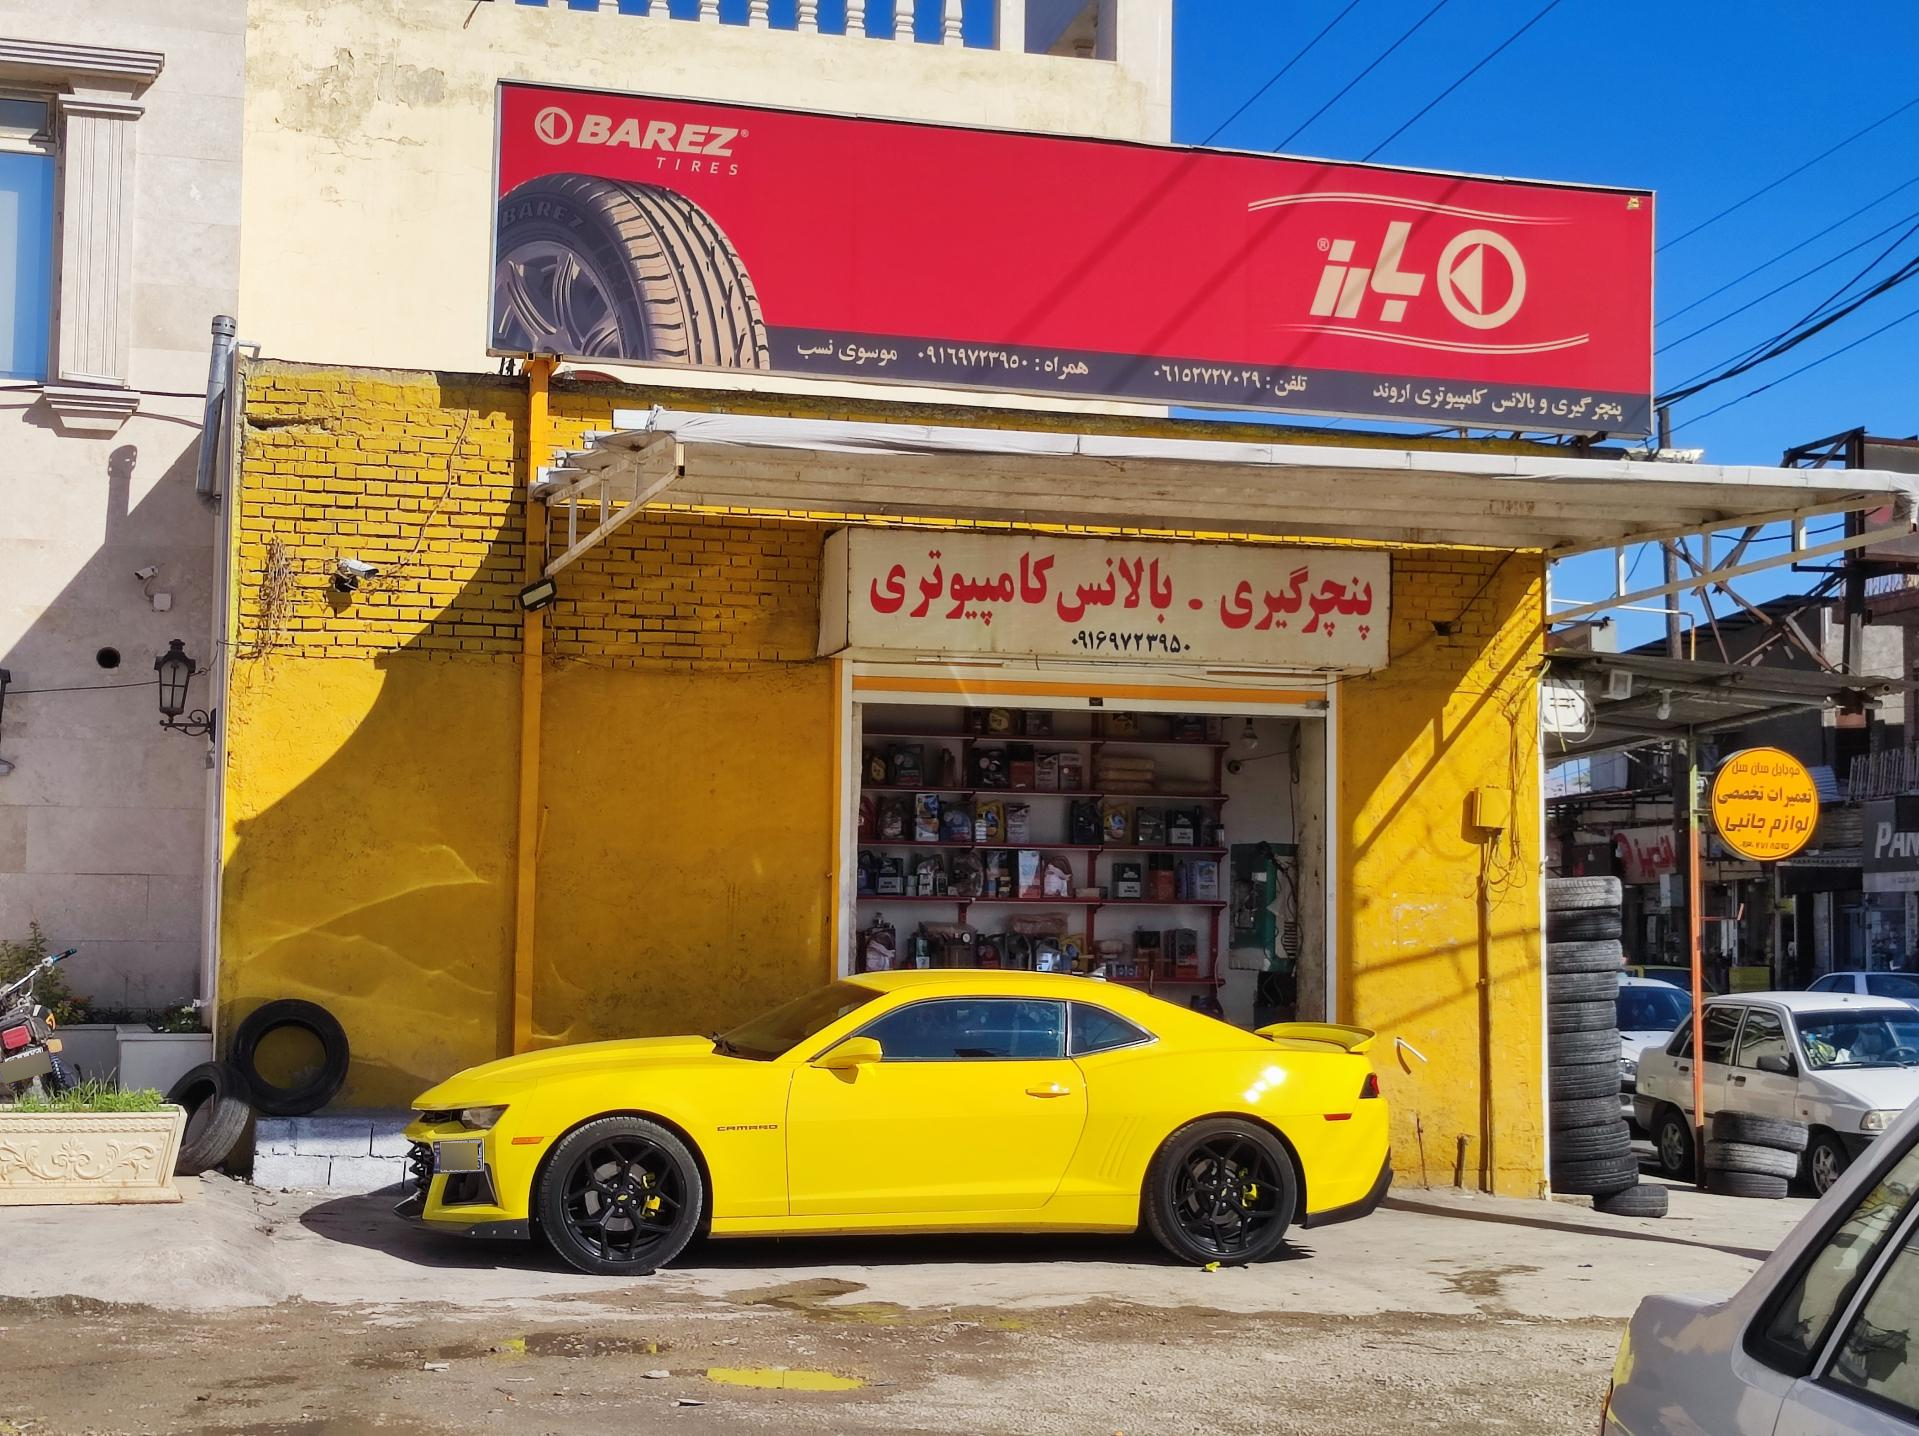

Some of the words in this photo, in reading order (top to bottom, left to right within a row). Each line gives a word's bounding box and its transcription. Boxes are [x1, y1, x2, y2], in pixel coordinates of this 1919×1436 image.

[577, 114, 738, 157] BAREZ
[656, 156, 738, 176] TIRES
[501, 201, 585, 232] BAREZ
[797, 339, 833, 360] نسب
[838, 342, 898, 367] موسوی
[1373, 382, 1411, 404] اروند
[1414, 386, 1487, 411] کامپیوتری
[1491, 392, 1536, 412] بالانس
[1539, 400, 1548, 414] و
[870, 550, 1055, 626] کامپیوتری
[1057, 556, 1172, 623] بالانس
[1220, 566, 1373, 640] پنچرگیری
[1771, 762, 1801, 778] موبایل
[1717, 785, 1764, 805] تخصصی
[1767, 787, 1812, 807] تعمیرات
[1724, 813, 1766, 832] جانبی
[1768, 815, 1809, 838] لوازم
[716, 1124, 778, 1132] CAMARO
